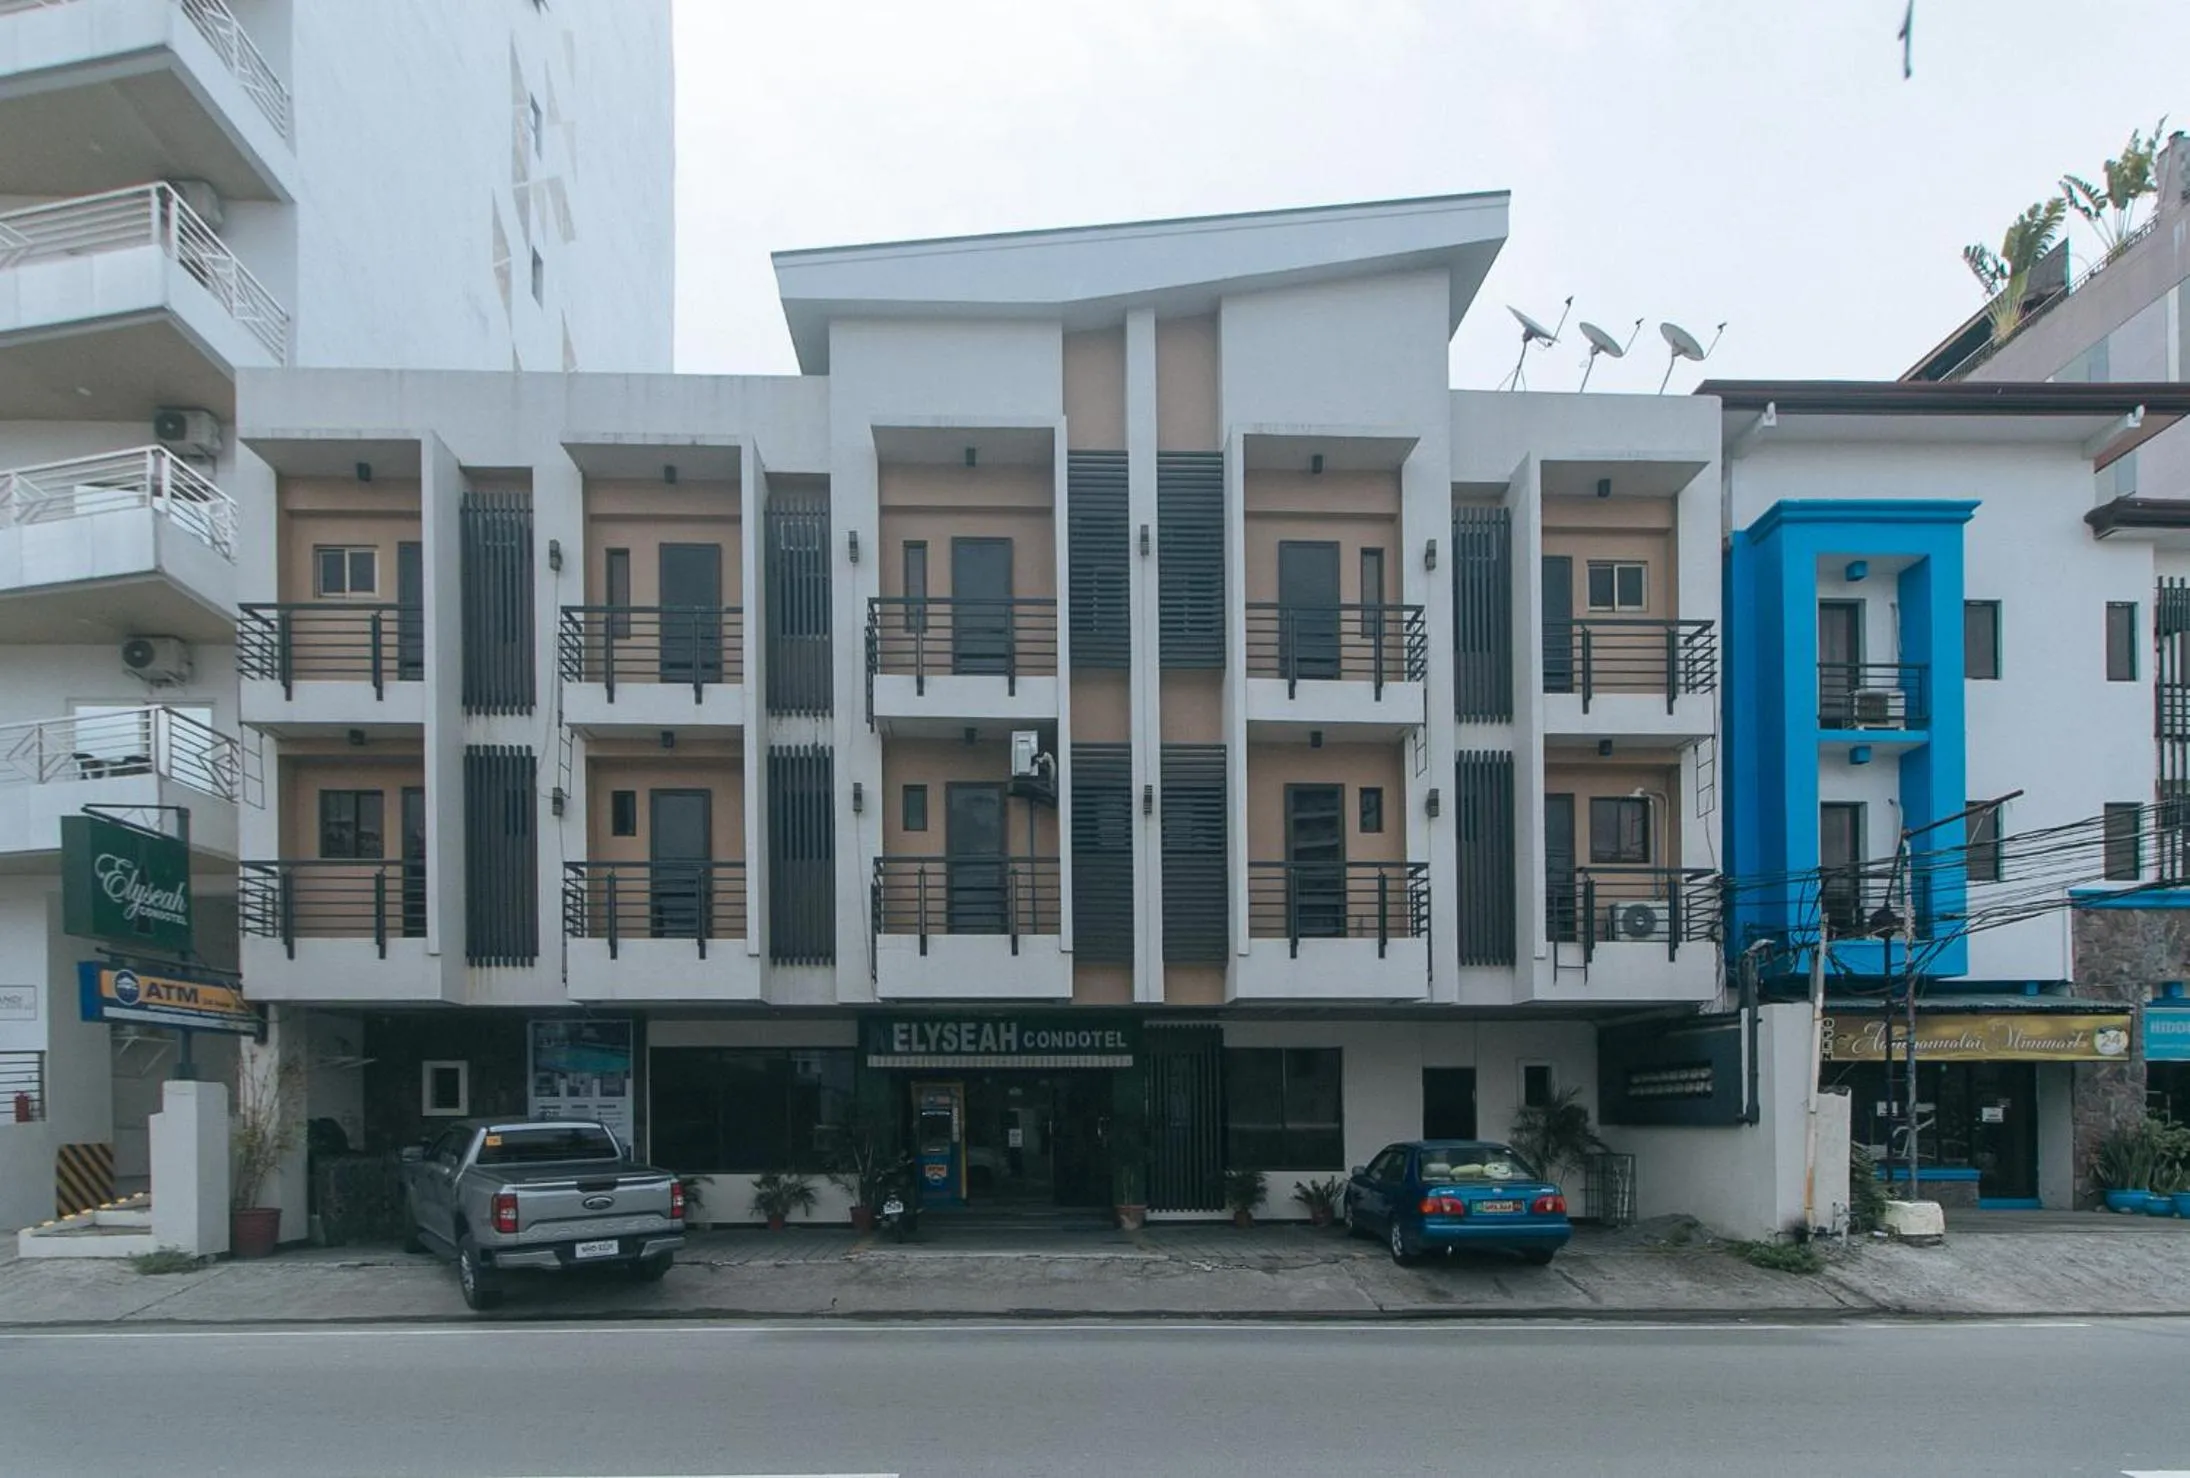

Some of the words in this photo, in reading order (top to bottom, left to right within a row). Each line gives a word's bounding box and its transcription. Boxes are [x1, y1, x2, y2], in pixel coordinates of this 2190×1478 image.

[95, 853, 188, 920] Elyseah
[146, 981, 200, 1004] ATM
[893, 1022, 1018, 1051] ELYSEAH
[1023, 1031, 1127, 1048] CONDOTEL
[1822, 1017, 1835, 1061] OPEN
